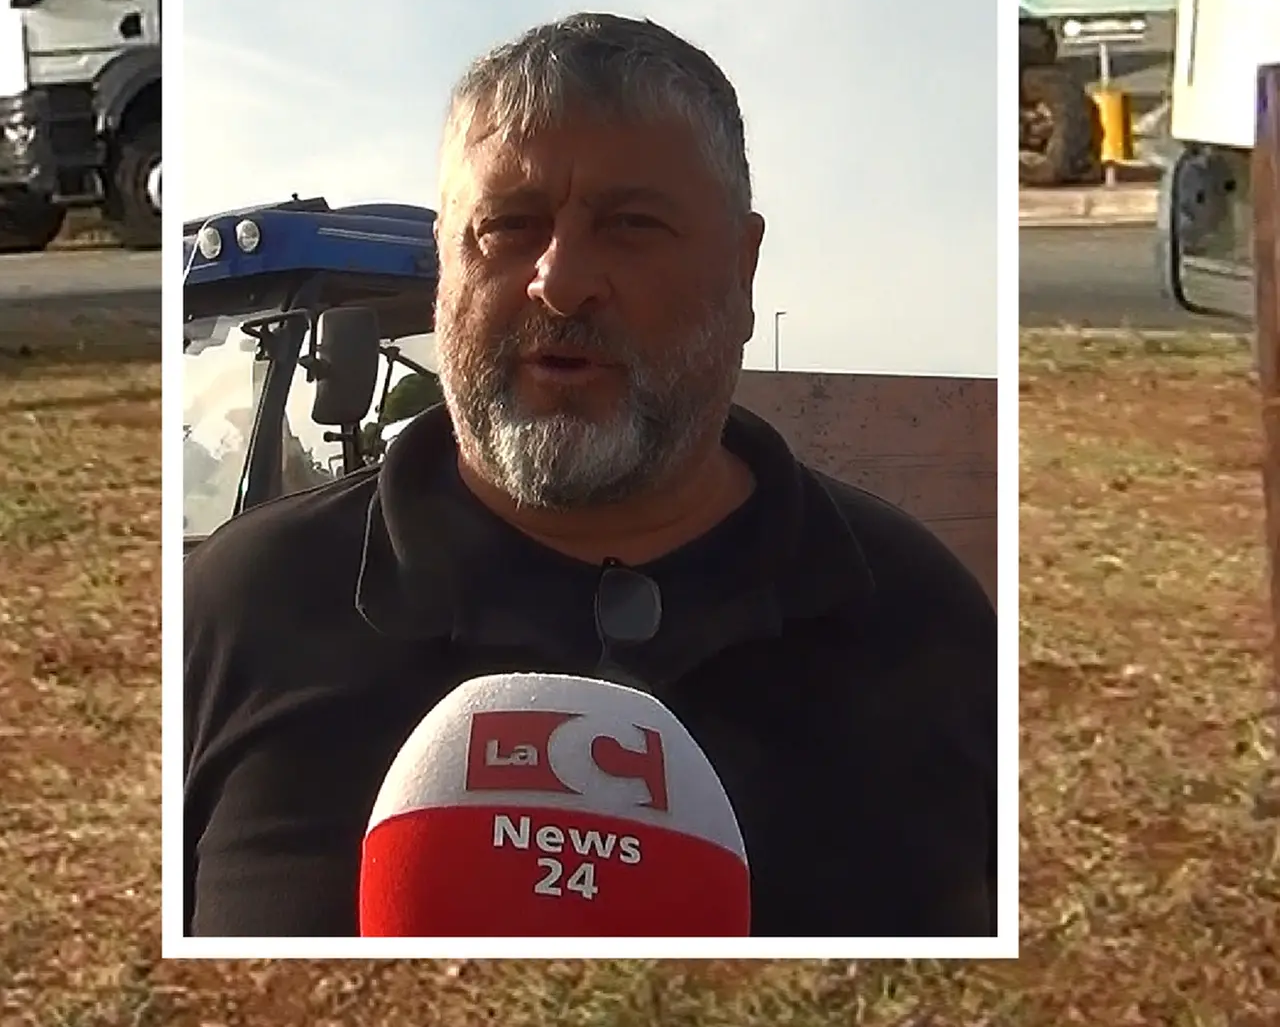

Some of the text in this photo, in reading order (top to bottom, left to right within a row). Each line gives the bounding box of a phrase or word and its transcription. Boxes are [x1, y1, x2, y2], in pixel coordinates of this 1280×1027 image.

[484, 739, 539, 767] La
[493, 814, 642, 864] News
[534, 857, 599, 900] 24
